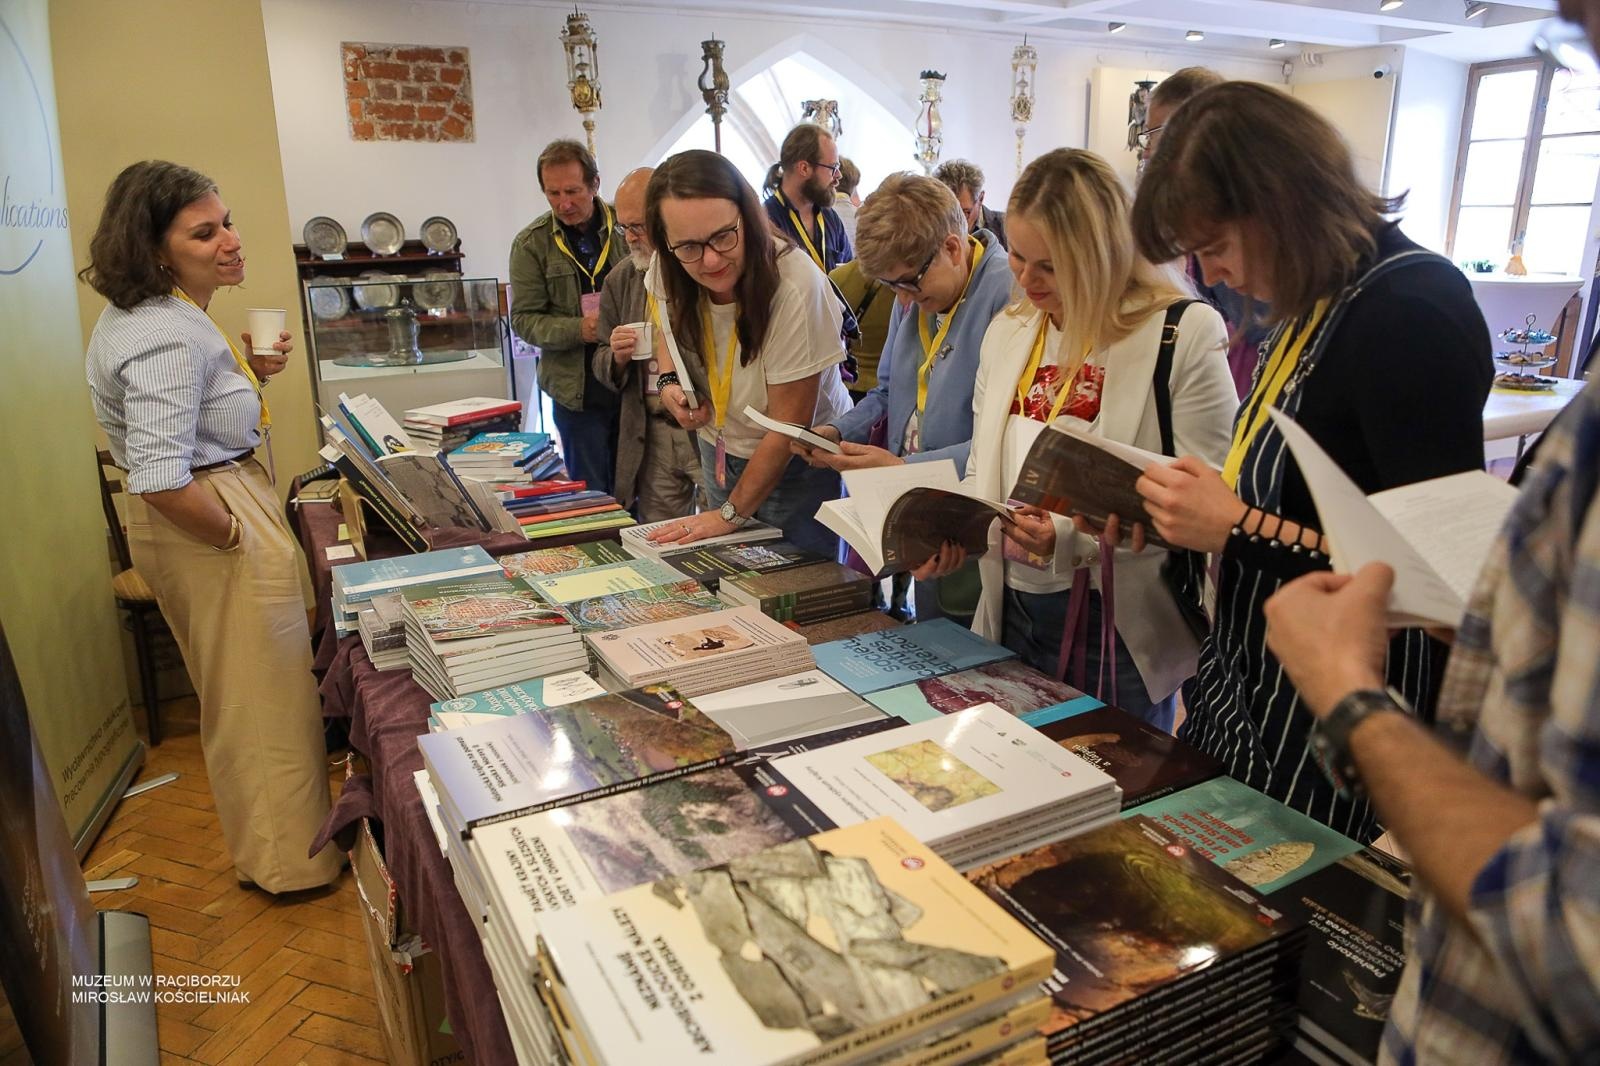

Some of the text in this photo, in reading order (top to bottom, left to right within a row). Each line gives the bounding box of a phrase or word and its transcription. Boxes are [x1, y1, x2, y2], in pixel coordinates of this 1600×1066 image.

[869, 640, 935, 677] centres
[1164, 815, 1196, 833] Czech
[1214, 844, 1230, 854] of
[1310, 918, 1393, 967] exploitation and
[1312, 911, 1402, 967] workshop area at
[1327, 940, 1387, 977] Prehistoric
